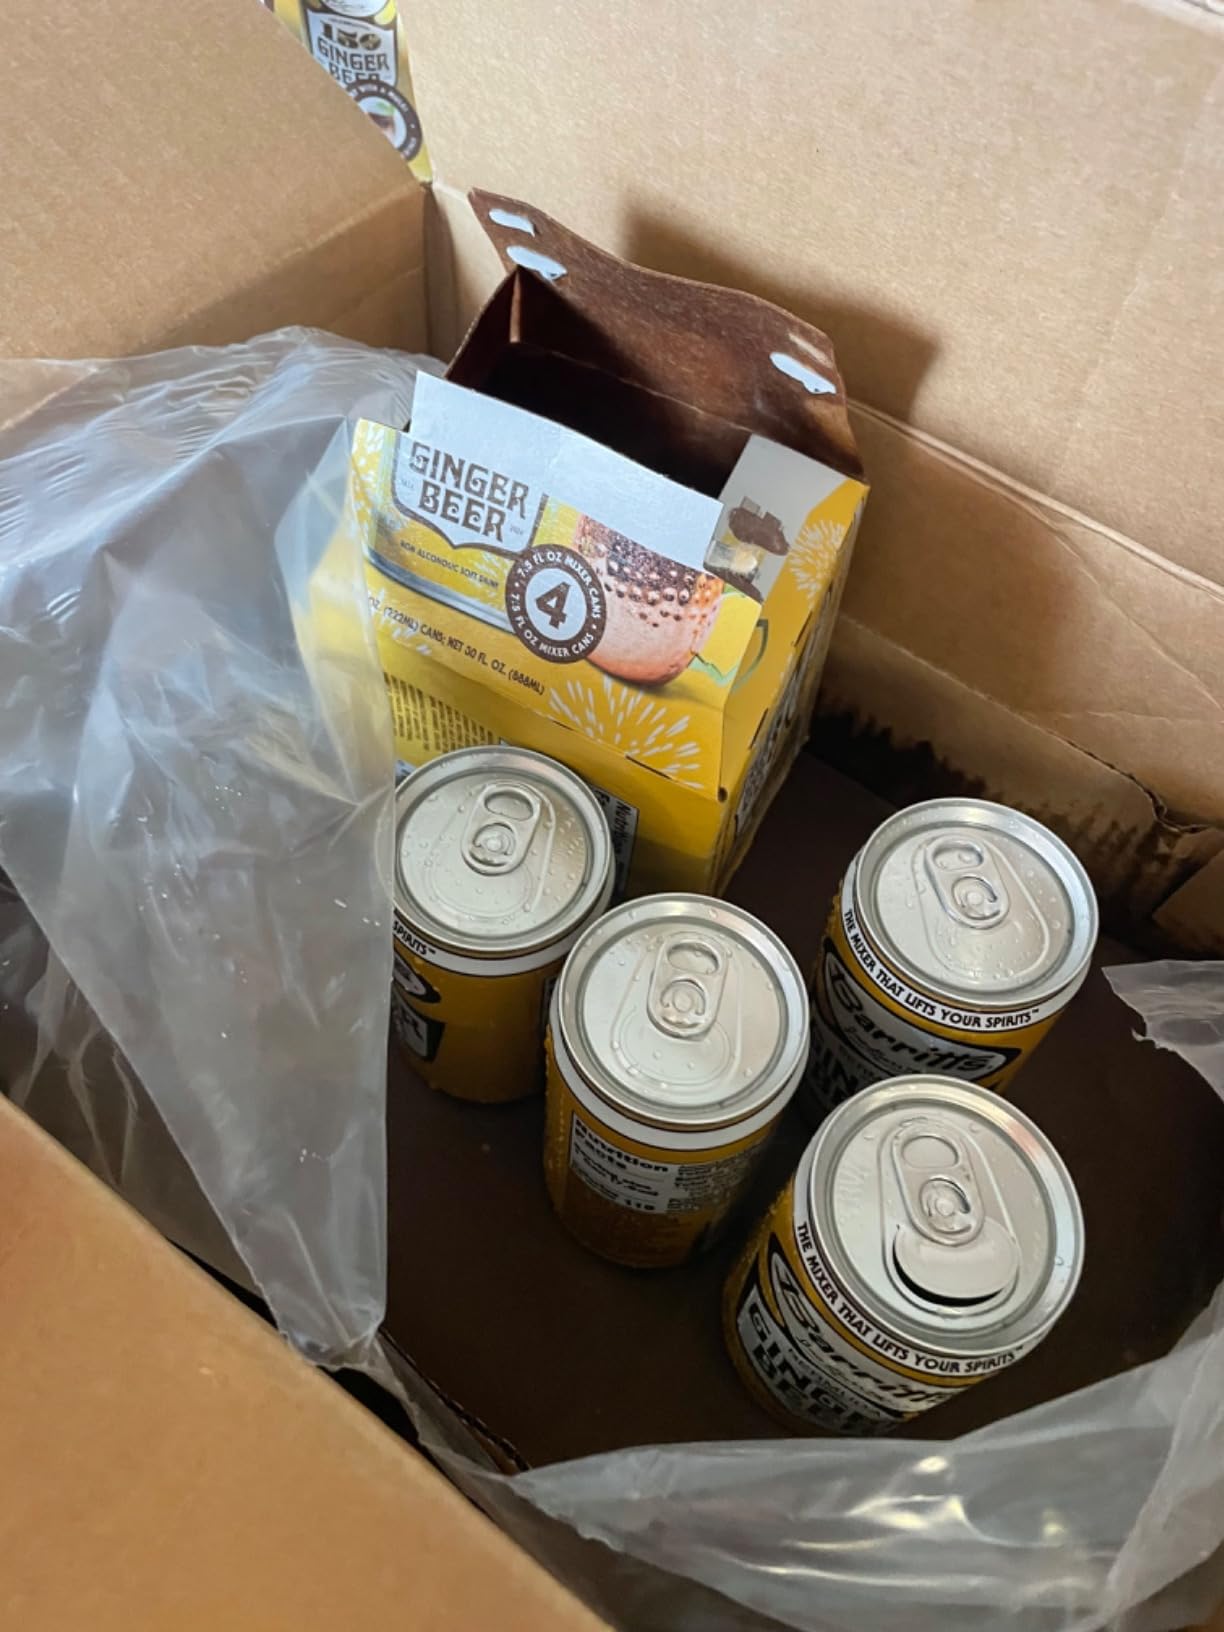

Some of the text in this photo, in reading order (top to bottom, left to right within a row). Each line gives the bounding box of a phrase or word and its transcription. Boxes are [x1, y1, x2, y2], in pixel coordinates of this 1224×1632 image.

[318, 36, 390, 71] GINGER
[408, 440, 529, 520] GINGER
[418, 480, 506, 543] BEER
[517, 551, 600, 619] 7.5 FL OZ MIXER CANS
[511, 594, 594, 656] 7.5 FL OZ MIXER CANS
[535, 581, 571, 630] 4
[447, 636, 464, 653] NET
[465, 645, 477, 659] 30
[844, 908, 857, 934] THE
[850, 933, 876, 973] MIXER
[876, 968, 905, 998] THAT
[904, 992, 937, 1017] LIFTS
[941, 1008, 981, 1029] YOUR
[797, 1221, 813, 1253] THE
[806, 1255, 839, 1306] MIXER
[838, 1302, 874, 1338] THAT
[871, 1334, 909, 1360] LIFTS
[914, 1354, 960, 1373] YOUR
